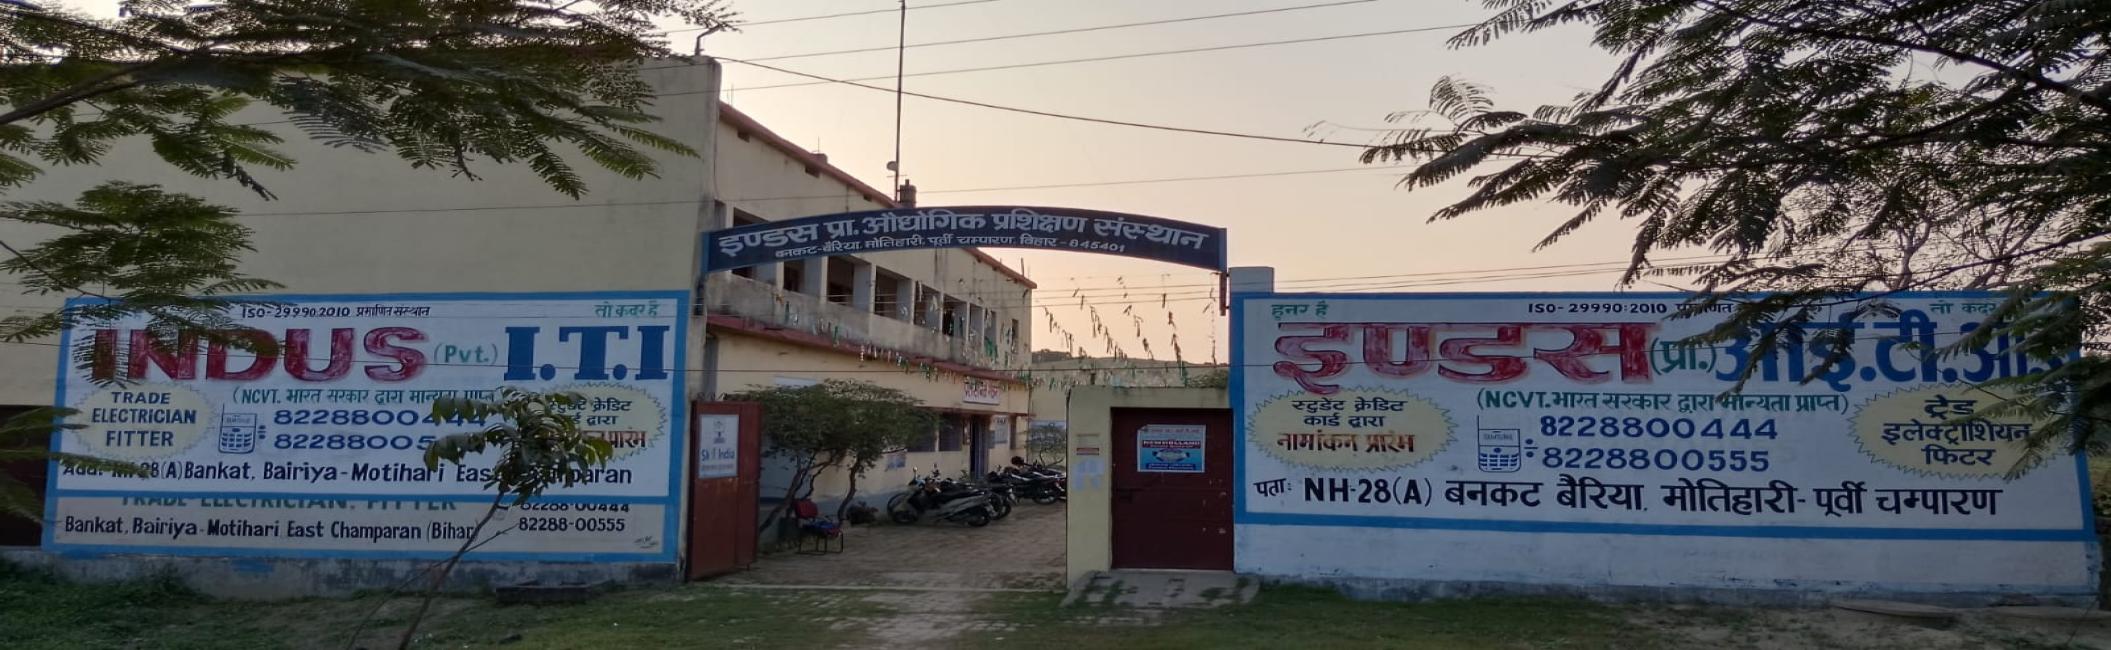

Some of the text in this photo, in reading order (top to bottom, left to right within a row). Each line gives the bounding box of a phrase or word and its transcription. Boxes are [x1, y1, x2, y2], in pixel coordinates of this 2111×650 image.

[719, 222, 819, 258] इण्डस
[990, 207, 1088, 233] प्रशिक्षण
[1093, 216, 1209, 250] संस्थान
[1271, 300, 1329, 320] हुनर है
[92, 325, 670, 382] INDUS (Pvt.) I.T.I
[1273, 321, 1657, 395] इण्डस
[111, 391, 171, 405] TRADE
[286, 388, 323, 404] भारत
[327, 388, 370, 404] सरकार
[375, 388, 402, 406] द्वारा
[591, 397, 633, 413] क्रेडिट
[1355, 396, 1408, 412] क्रेडिट
[1603, 392, 1672, 411] सरकार
[1678, 392, 1715, 414] द्वारा
[1924, 394, 1978, 419] ट्रेड
[91, 408, 197, 425] ELECTRICIAN
[586, 414, 618, 426] द्वारा
[1304, 412, 1385, 428] कार्ड द्वारा
[1540, 415, 1777, 440] 8228800444
[105, 430, 173, 447] FITTER
[1277, 429, 1358, 452] नामांकन
[1543, 447, 1770, 472] 8228800555
[1921, 443, 1997, 466] फिटर
[456, 464, 497, 483] Eas
[1303, 476, 1432, 507] NH-28(A)
[1445, 479, 1544, 507] बनकट
[1812, 480, 1867, 517] पूर्वी
[1874, 488, 2003, 516] चम्पारण
[287, 521, 324, 538] East
[330, 521, 421, 544] Champaran
[519, 516, 625, 532] 82288-00555
